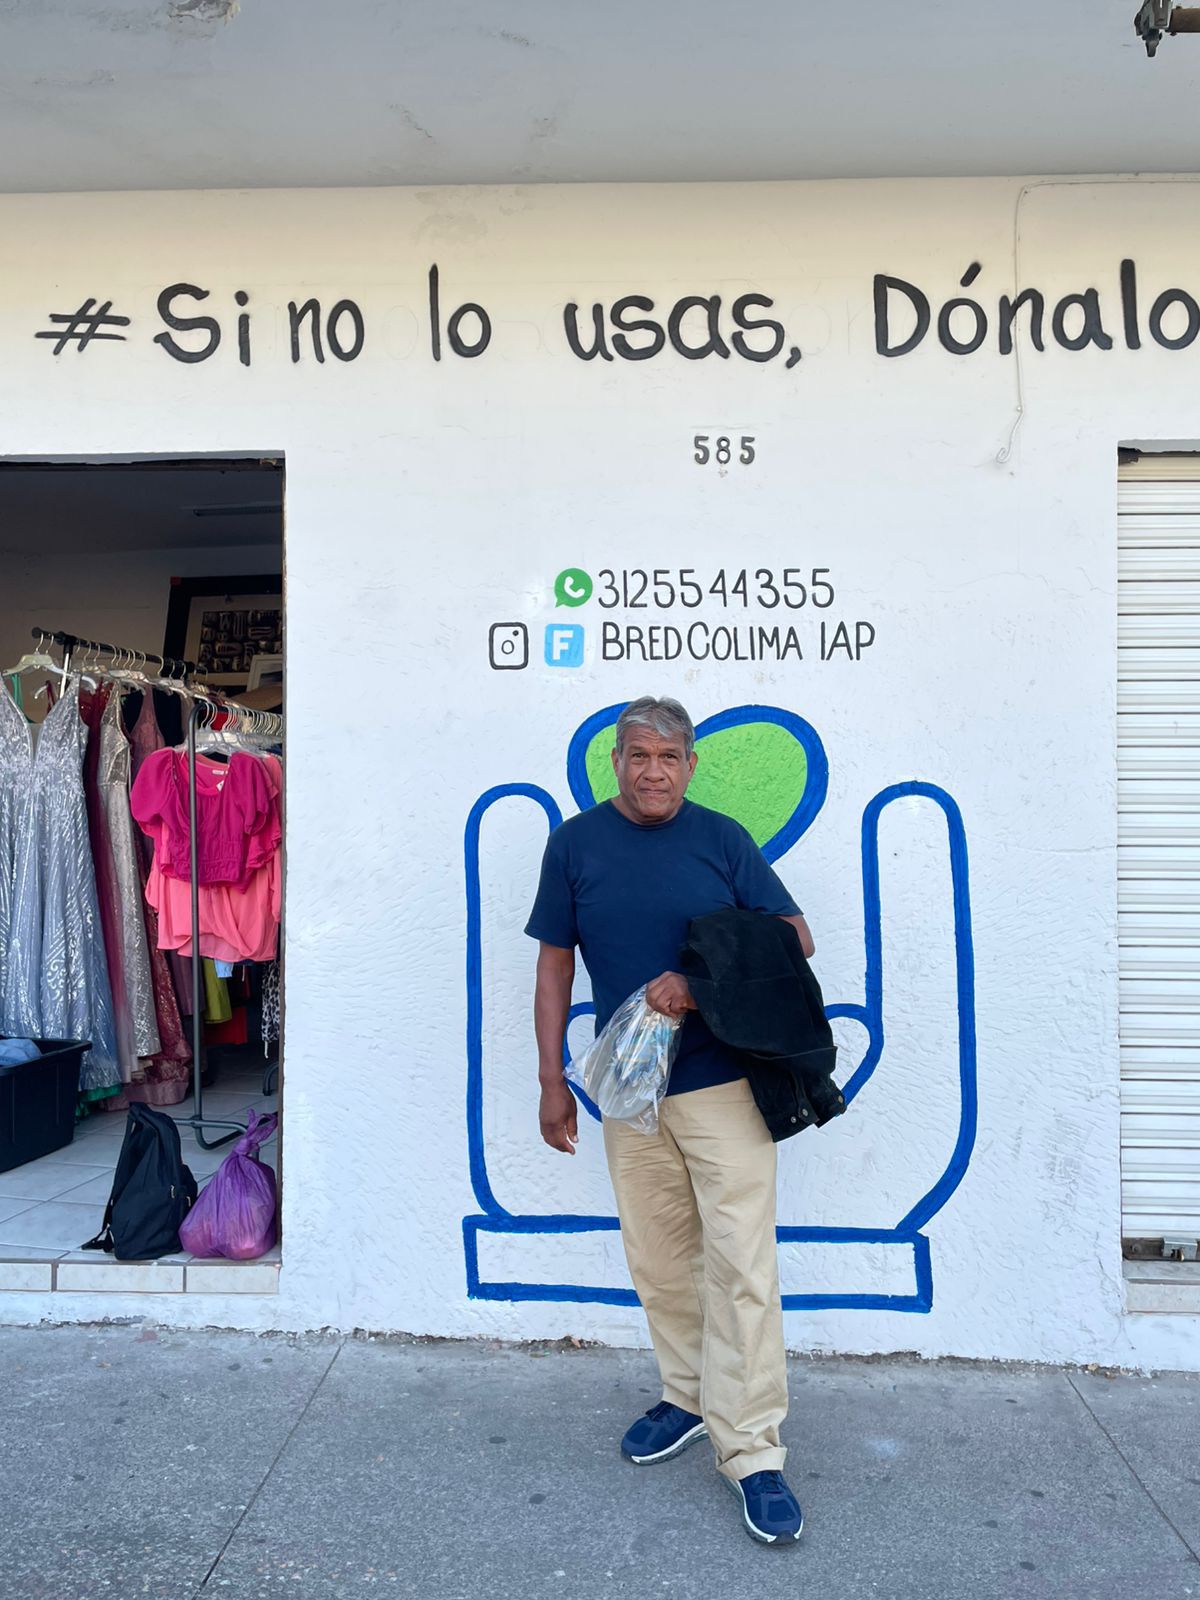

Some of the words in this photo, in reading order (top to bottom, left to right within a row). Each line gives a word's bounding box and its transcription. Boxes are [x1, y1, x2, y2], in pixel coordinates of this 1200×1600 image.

[429, 263, 492, 362] lo
[563, 293, 802, 369] usas,
[873, 258, 1200, 358] Dónalo
[694, 436, 755, 465] 585
[598, 568, 835, 609] 3125544355
[820, 621, 875, 661] IAP
